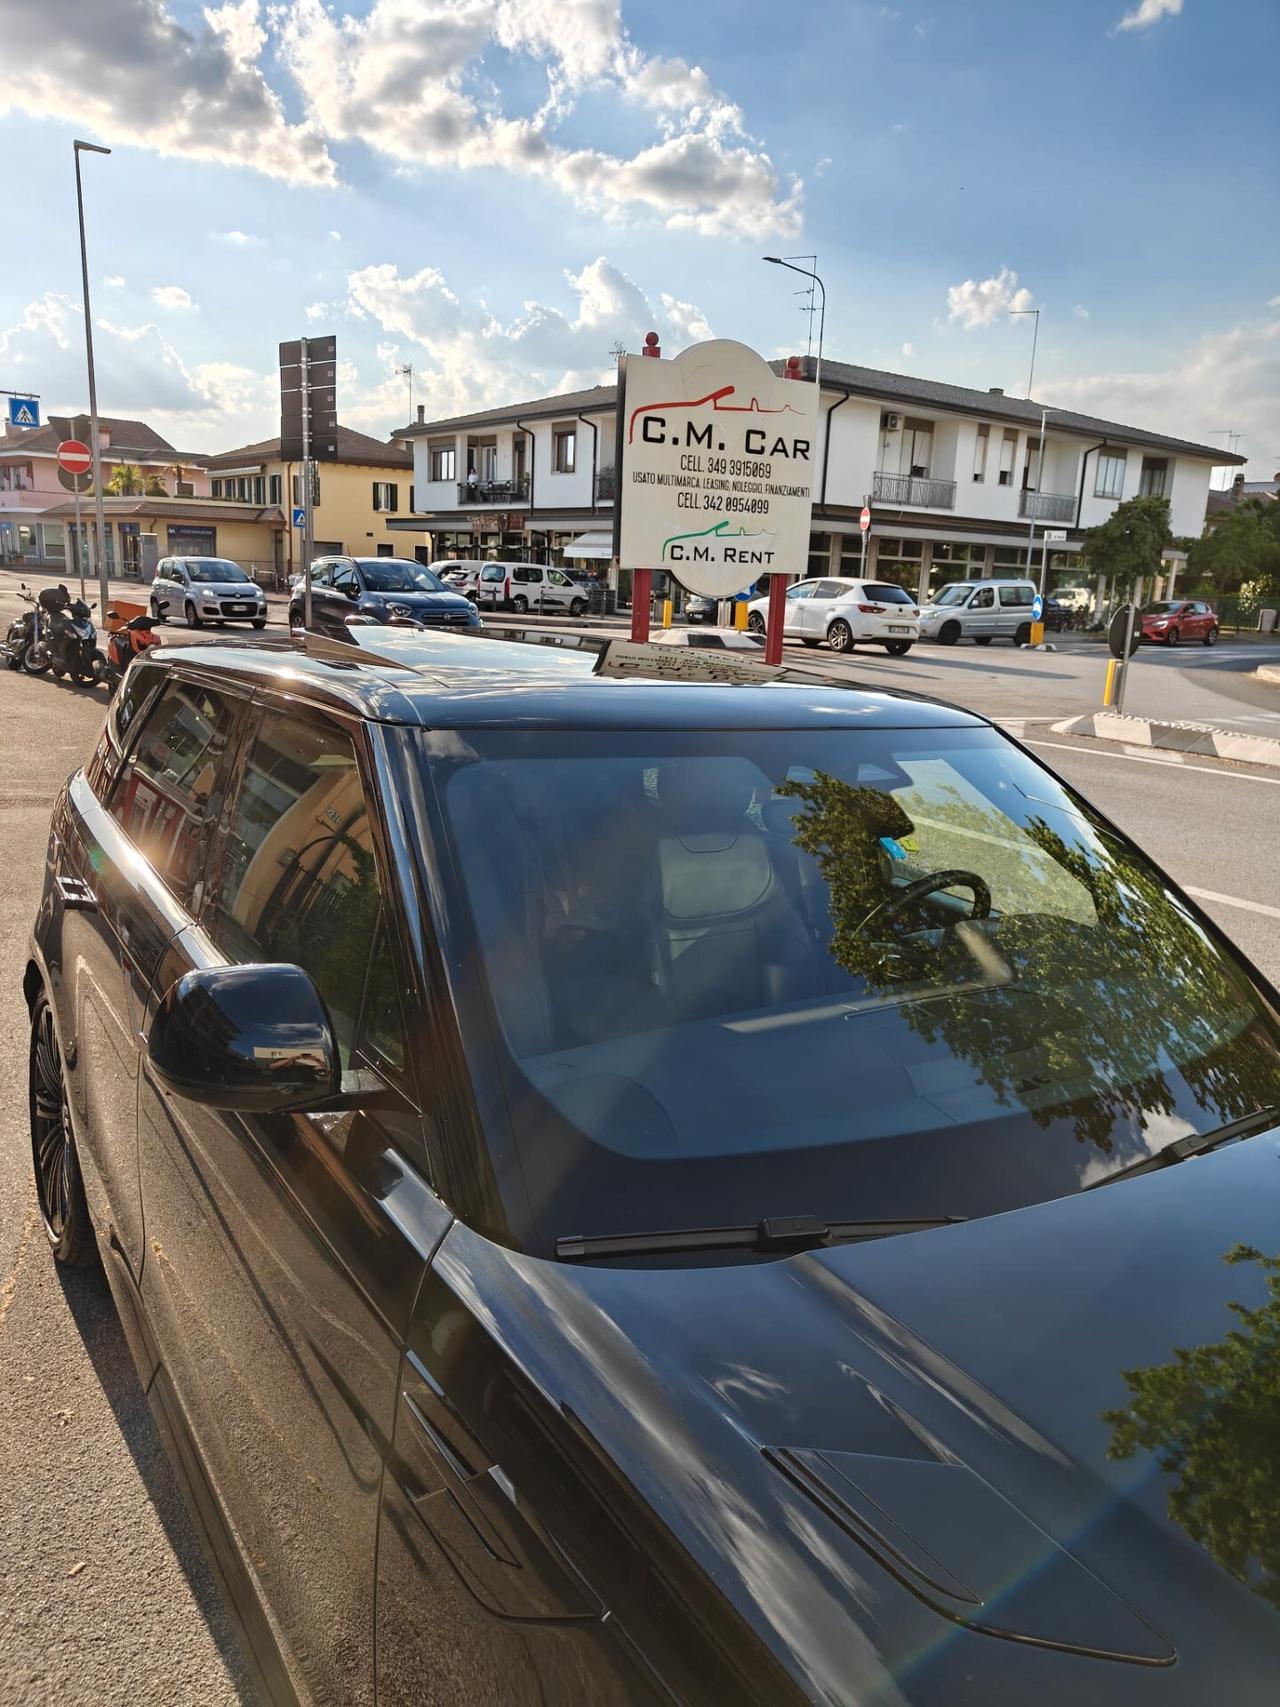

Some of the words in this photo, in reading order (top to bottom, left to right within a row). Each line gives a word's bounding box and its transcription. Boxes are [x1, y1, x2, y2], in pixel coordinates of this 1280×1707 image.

[642, 415, 725, 451] C.M.
[680, 454, 705, 473] CELL.
[707, 457, 727, 474] 349
[729, 459, 772, 479] 3915069
[632, 471, 656, 485] USATO
[764, 483, 811, 498] FINANZIAMENTI
[677, 492, 702, 510] CELL.
[703, 494, 723, 511] 342
[725, 496, 769, 514] 0954099
[670, 544, 715, 562] C.M.
